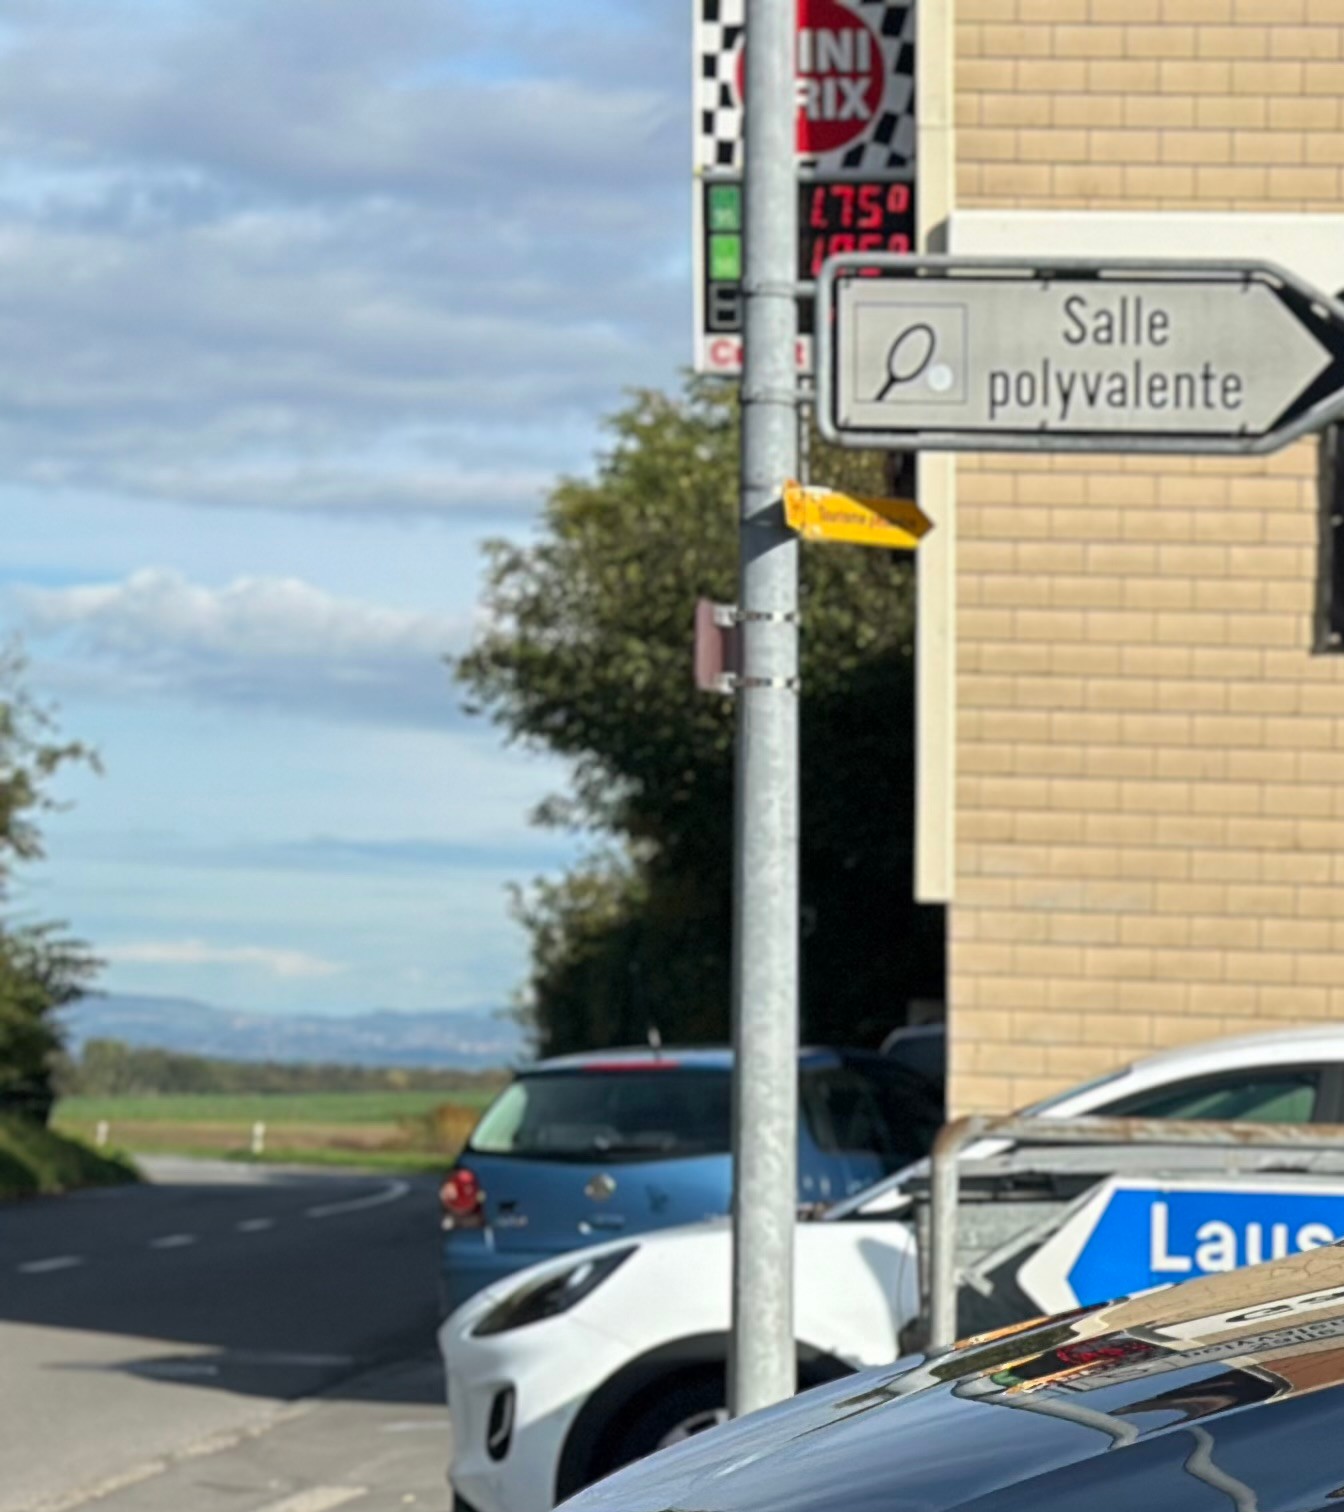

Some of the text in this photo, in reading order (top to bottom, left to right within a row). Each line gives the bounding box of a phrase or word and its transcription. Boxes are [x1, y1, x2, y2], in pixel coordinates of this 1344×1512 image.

[798, 29, 871, 73] INI
[796, 77, 871, 121] RIX
[1063, 295, 1169, 346] Salle
[988, 358, 1243, 420] polyvalente
